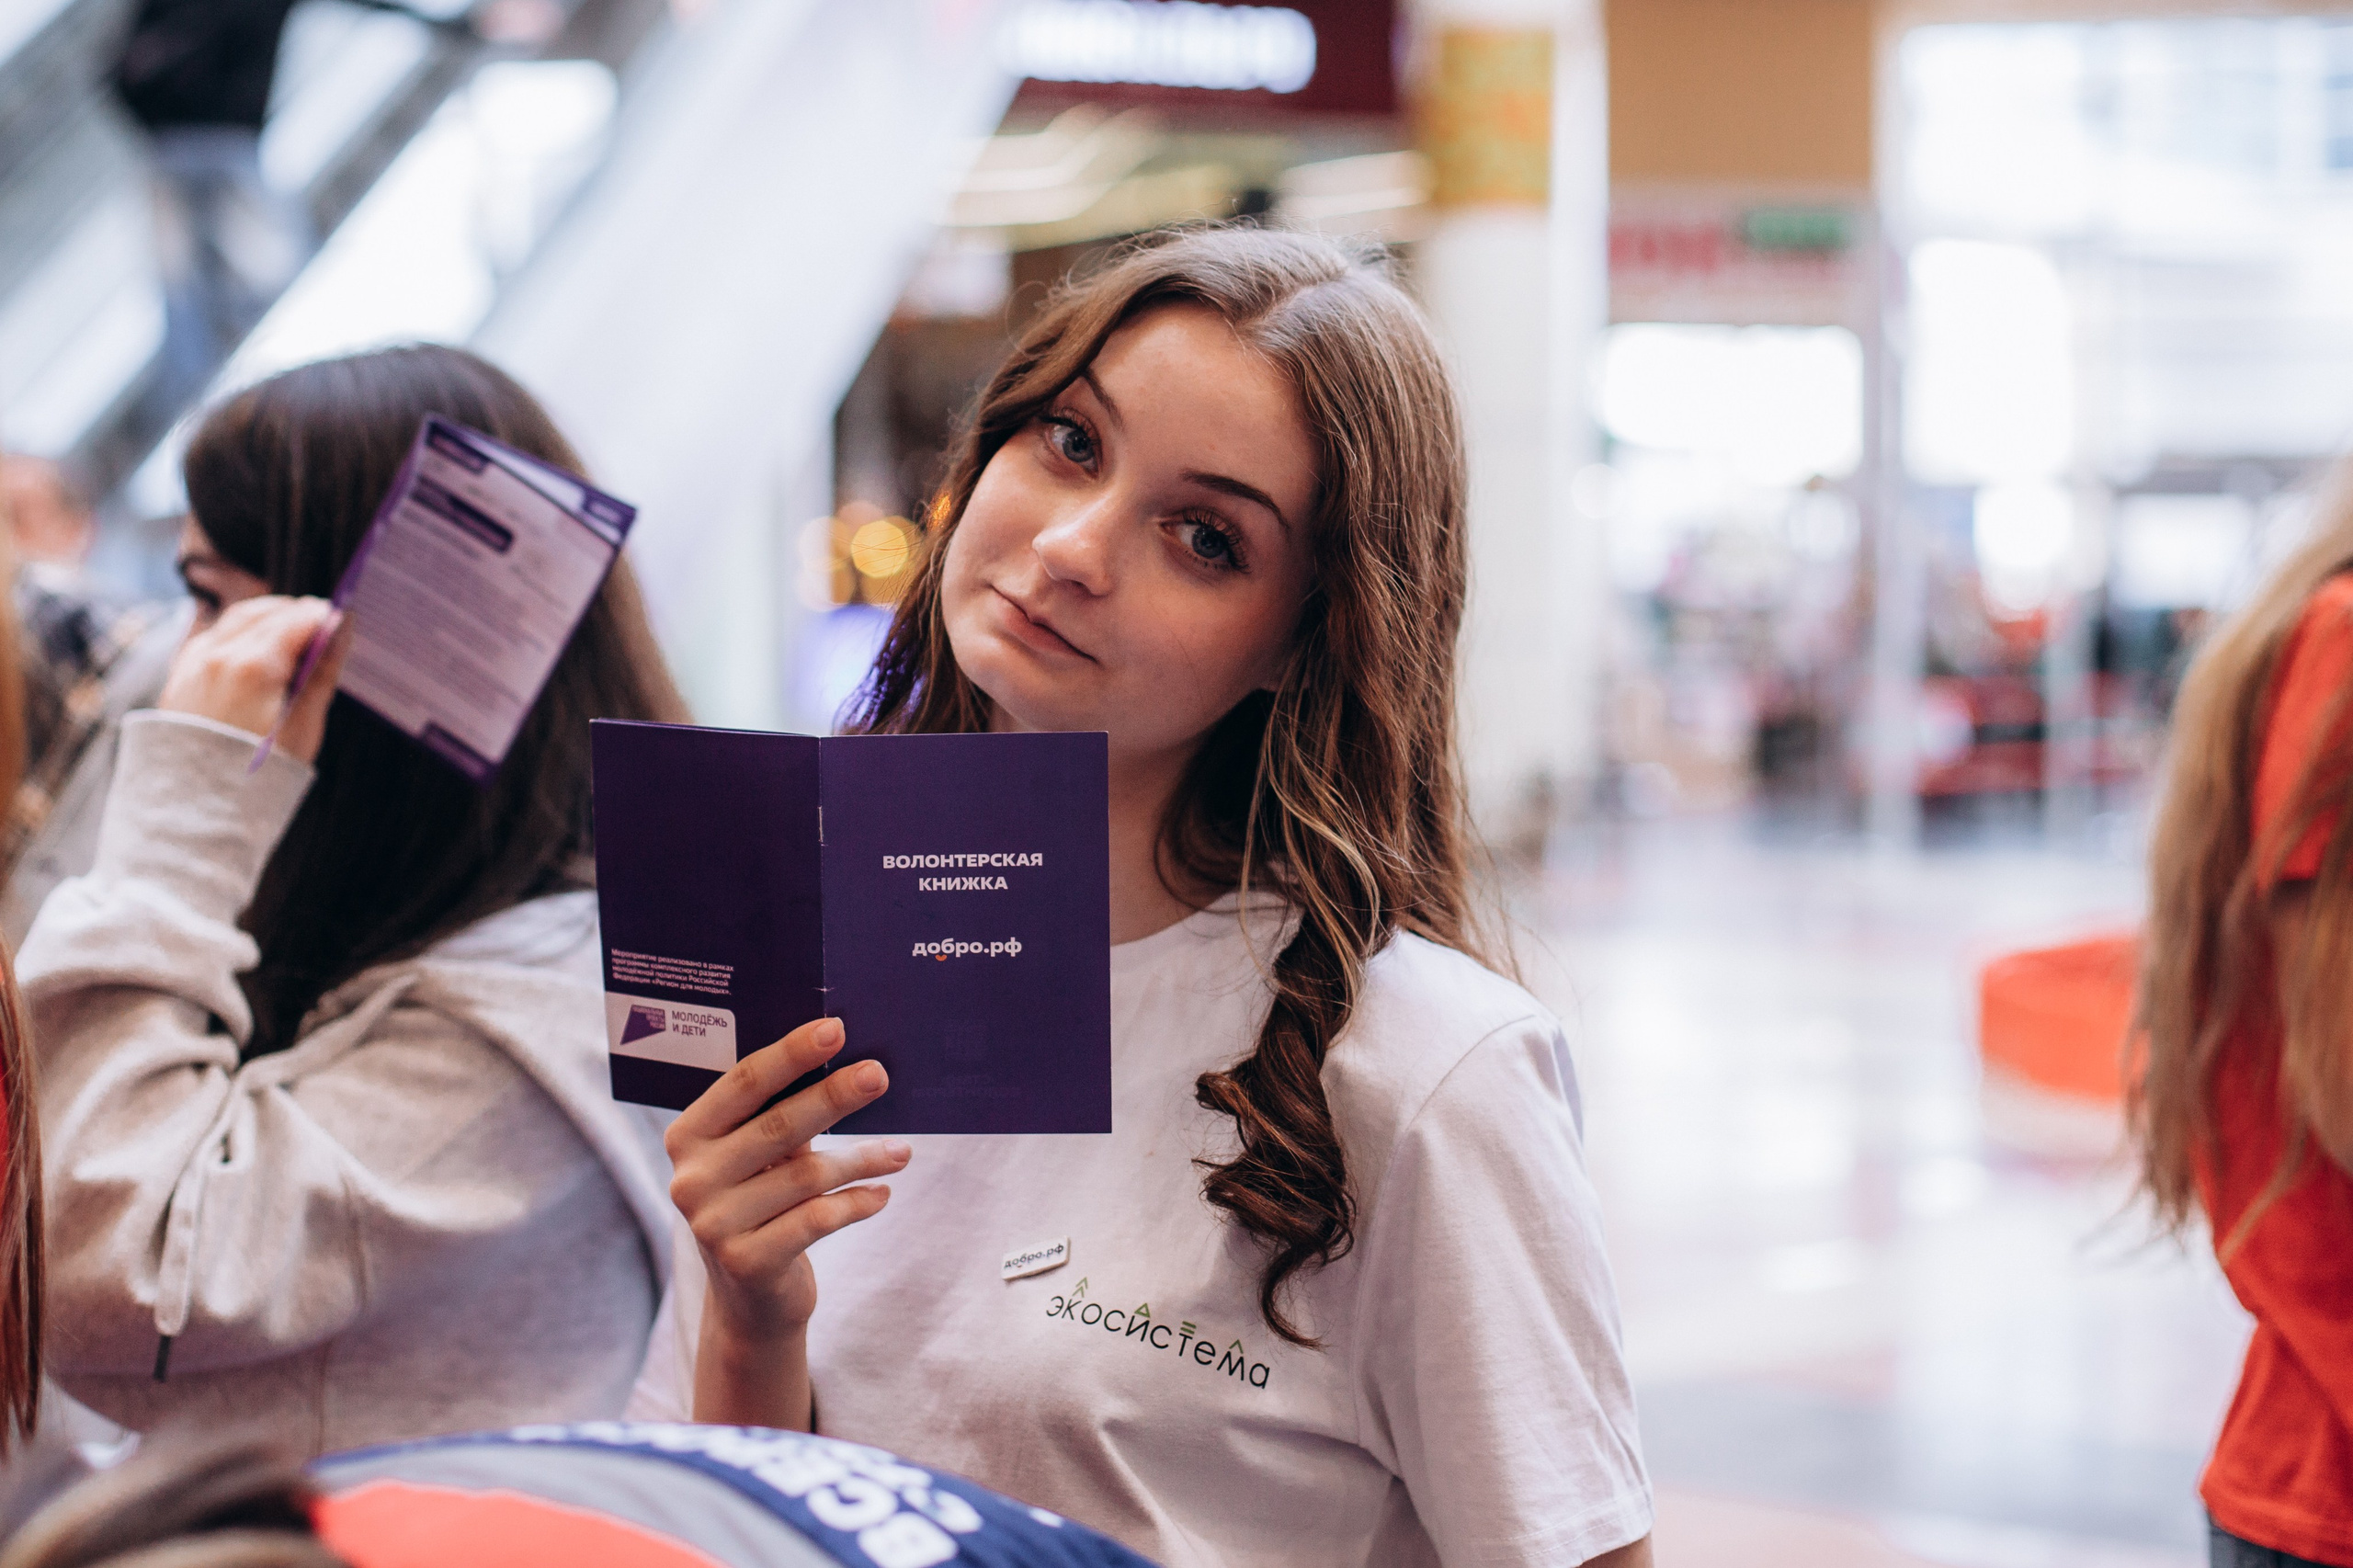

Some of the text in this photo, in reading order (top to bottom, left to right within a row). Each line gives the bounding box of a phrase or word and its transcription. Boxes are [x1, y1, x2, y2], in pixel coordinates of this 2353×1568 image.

[882, 853, 1043, 869] ВОЛОНТЕРСКАЯ
[918, 876, 1008, 892] КНИЖКА
[912, 937, 1022, 958] добро.рф
[611, 949, 656, 961] Мероприятие
[658, 957, 701, 967] реализовано
[709, 963, 733, 971] рамках
[651, 963, 698, 975] комплексного
[699, 970, 731, 979] развития
[655, 971, 688, 982] политики
[688, 975, 729, 986] Российской
[672, 1011, 727, 1028] МОЛОДЁЖЬ
[673, 1023, 706, 1037] И ДЕТИ
[1004, 1244, 1064, 1268] добро.рф
